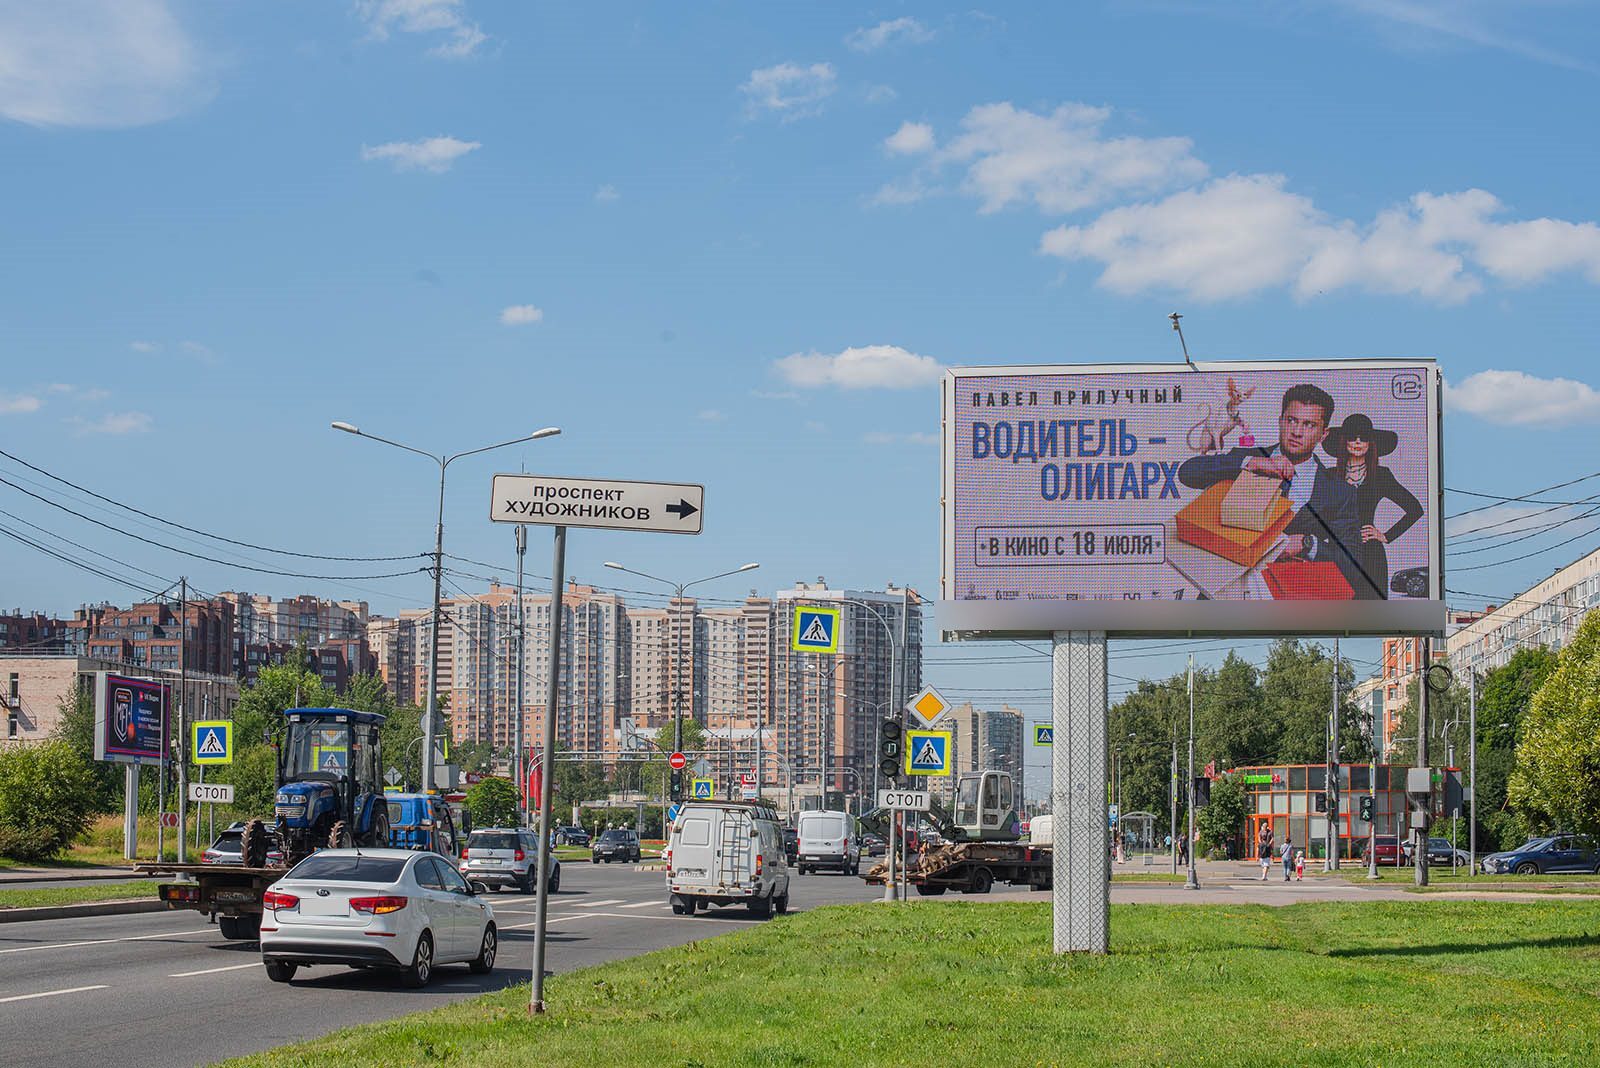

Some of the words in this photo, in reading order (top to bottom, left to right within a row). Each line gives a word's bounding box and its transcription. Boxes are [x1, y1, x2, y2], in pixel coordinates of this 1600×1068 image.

[972, 391, 1038, 407] ПАВЕЛ
[1053, 385, 1182, 406] ПРИЛУЧНЫЙ
[972, 418, 1138, 464] ВОДИТЕЛЬ
[1041, 461, 1181, 501] ОЛИГАРХ
[533, 485, 624, 502] проспект
[505, 500, 650, 521] ХУДОЖНИКОВ
[989, 537, 999, 556] В
[1005, 536, 1049, 556] КИНО
[1055, 536, 1064, 556] С
[1073, 531, 1095, 556] 18
[1104, 534, 1153, 555] ИЮЛЯ
[195, 786, 227, 799] СТОП
[886, 792, 923, 808] СТОП
